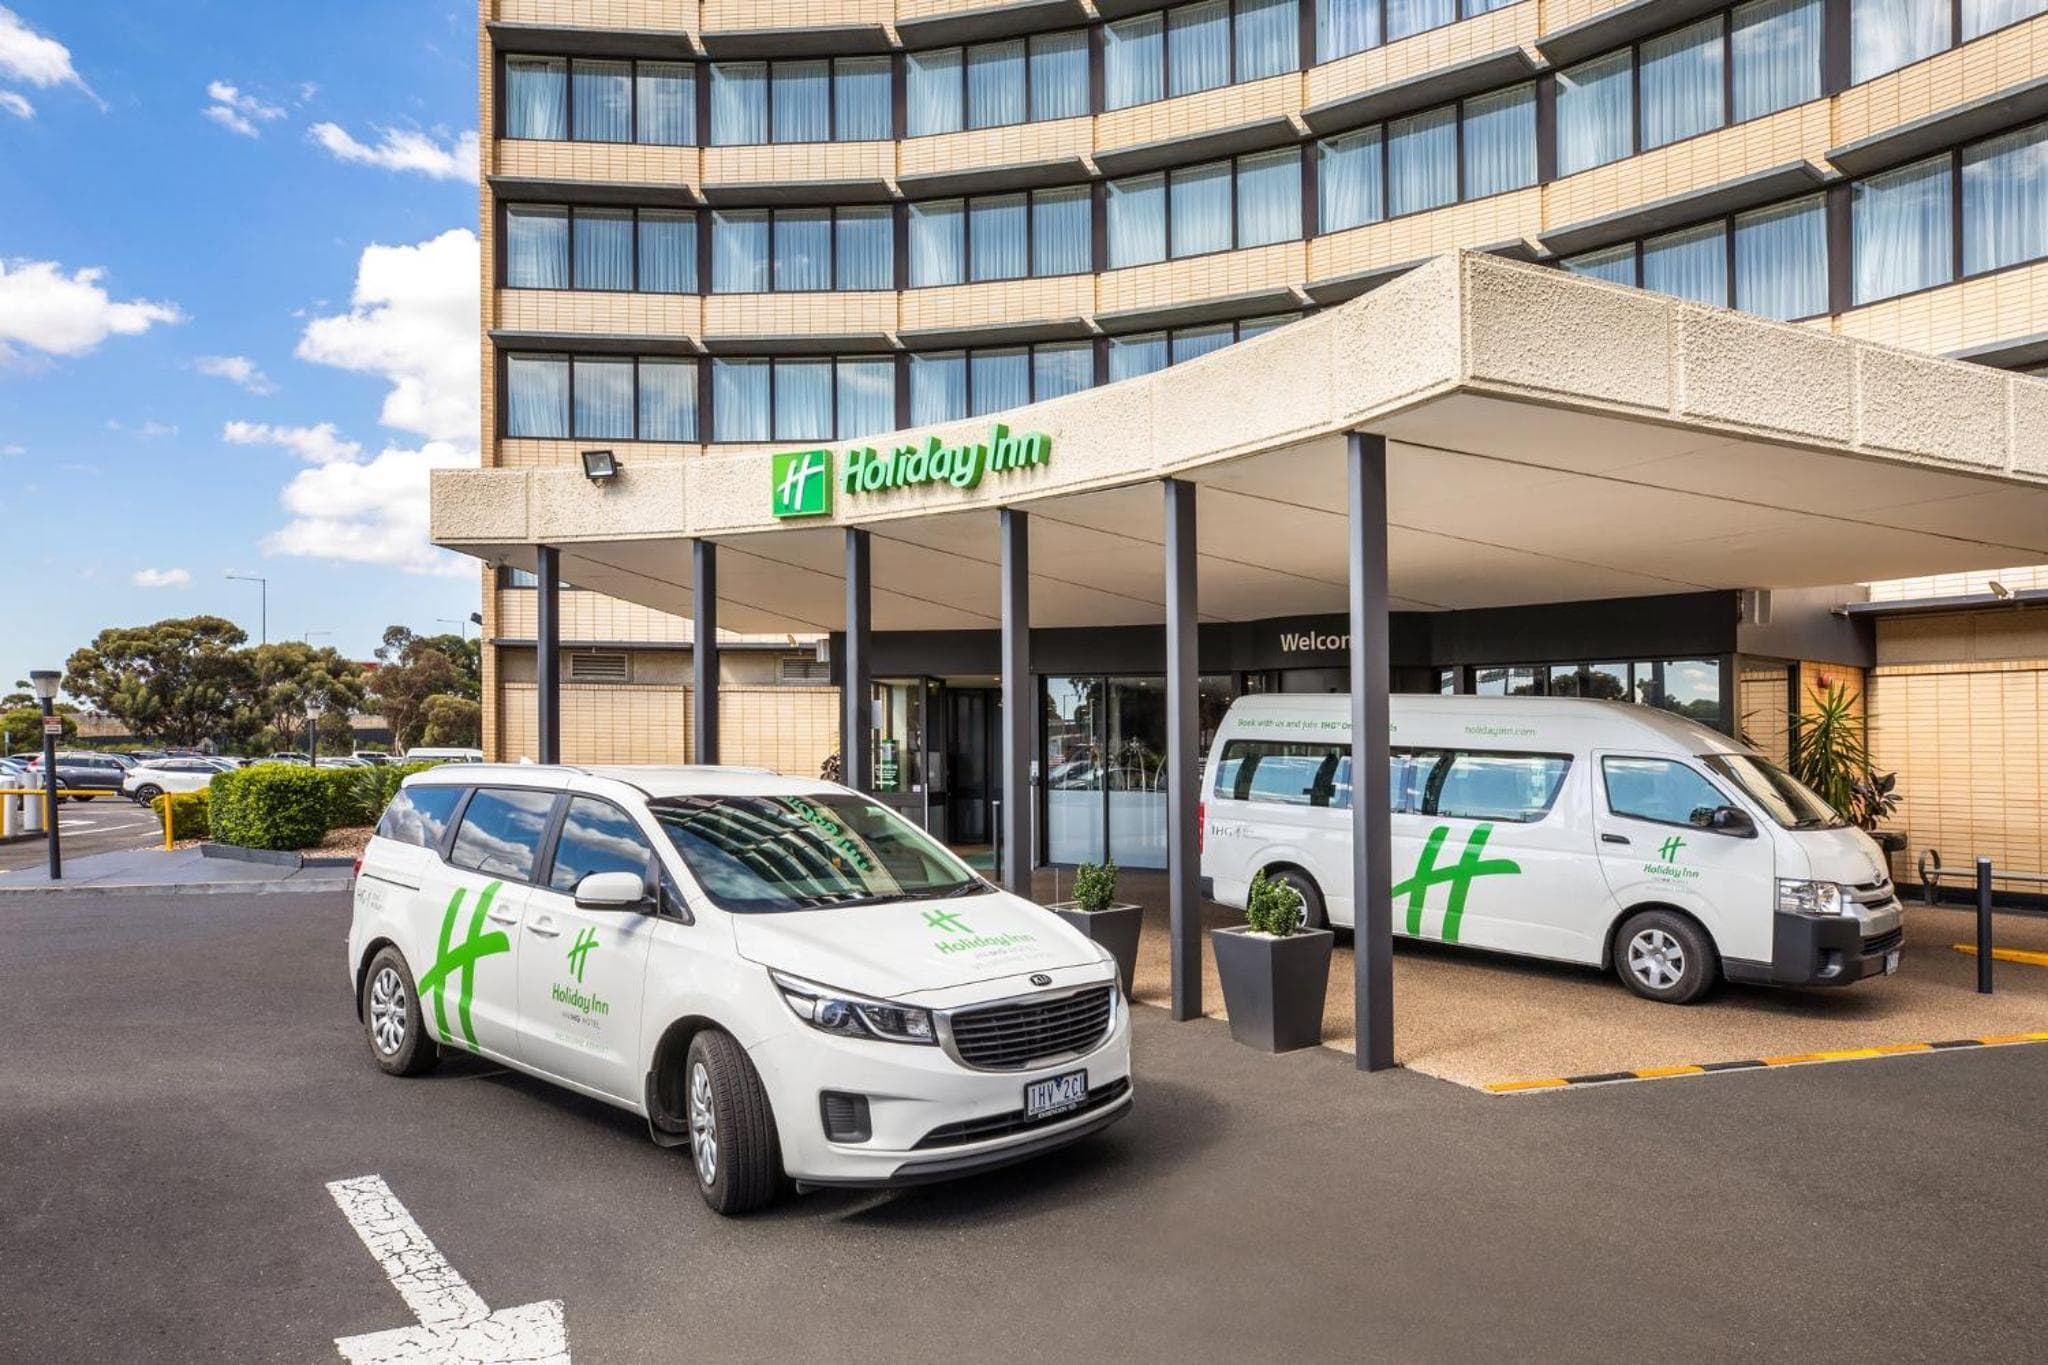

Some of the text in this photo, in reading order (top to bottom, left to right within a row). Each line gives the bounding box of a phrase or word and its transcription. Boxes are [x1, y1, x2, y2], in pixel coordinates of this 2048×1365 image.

[842, 424, 1051, 494] Holiday Inn
[1280, 631, 1351, 652] Welco
[1643, 864, 1700, 879] Holiday Inn
[935, 935, 1011, 954] Holiday
[552, 982, 609, 1016] Holiday Inn
